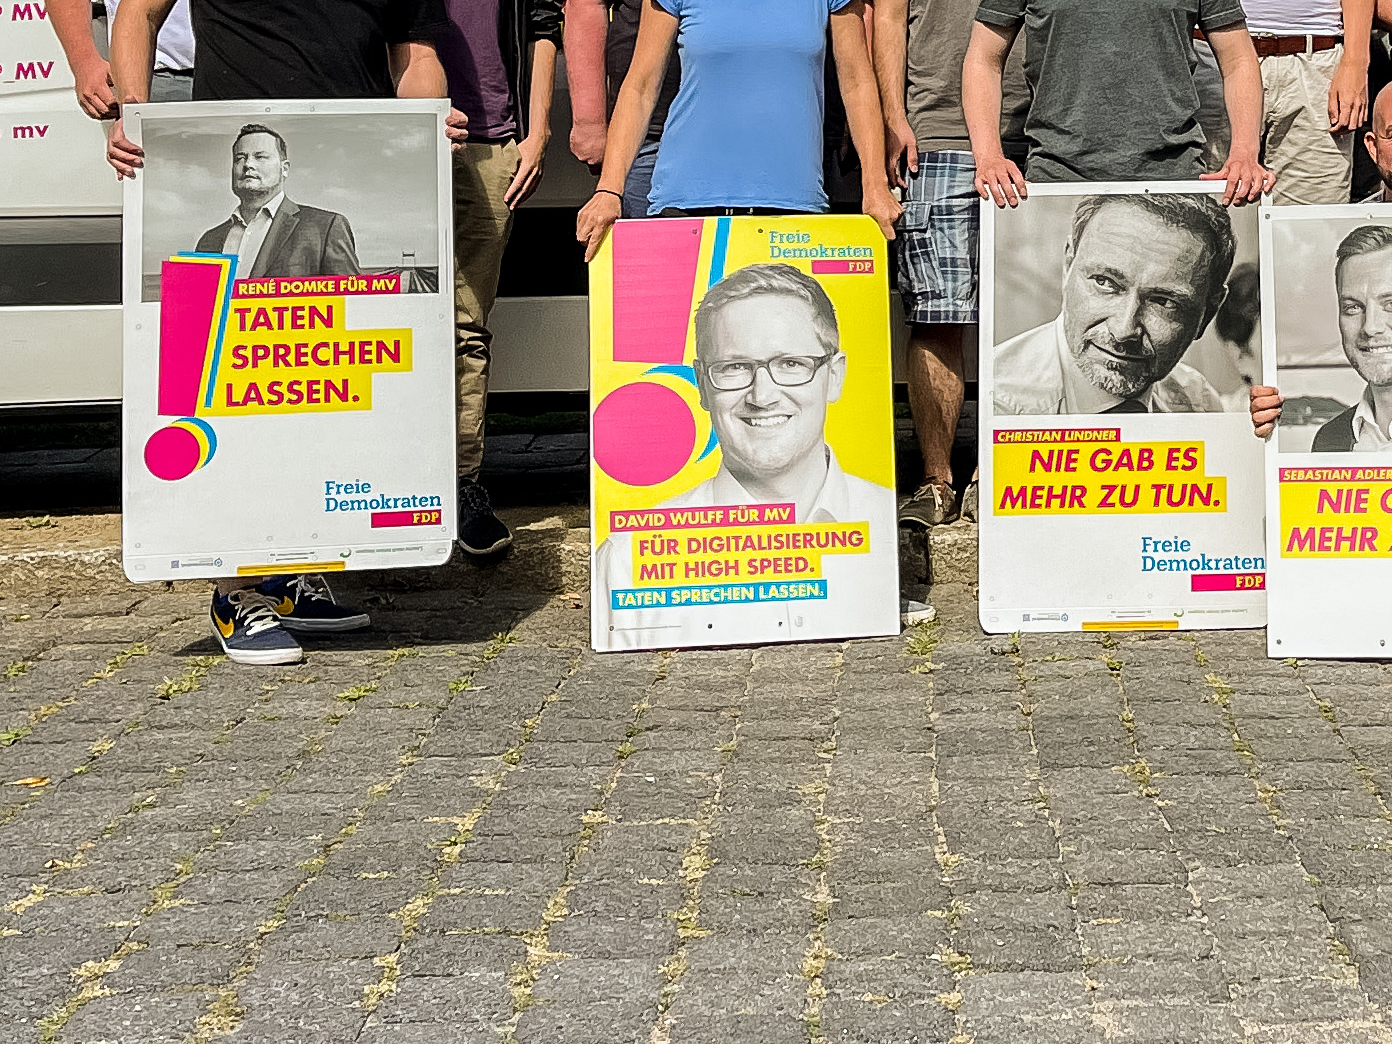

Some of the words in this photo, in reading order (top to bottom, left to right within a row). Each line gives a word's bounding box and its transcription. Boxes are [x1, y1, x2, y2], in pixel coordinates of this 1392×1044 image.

[11, 3, 48, 21] MV
[12, 125, 49, 138] mv
[769, 230, 810, 244] Freie
[769, 244, 874, 258] Demokraten
[848, 260, 872, 272] FDP
[238, 278, 276, 295] RENÉ
[280, 279, 335, 294] DOMKE
[340, 276, 368, 292] FÜR
[371, 278, 397, 291] MV
[234, 305, 333, 331] TATEN
[231, 339, 400, 370] SPRECHEN
[226, 378, 360, 407] LASSEN.
[997, 431, 1061, 442] CHRISTIAN
[1064, 430, 1117, 441] LINDNER
[1029, 448, 1080, 473] NIE
[1089, 447, 1154, 472] GAB
[1165, 447, 1198, 472] ES
[1283, 469, 1352, 481] SEBASTIAN
[325, 478, 371, 496] Freie
[999, 485, 1087, 509] MEHR
[1097, 484, 1140, 508] ZU
[1150, 483, 1221, 507] TUN.
[324, 493, 442, 512] Demokraten
[1317, 488, 1370, 514] NIE
[412, 512, 440, 524] FDP
[614, 513, 665, 529] DAVID
[669, 510, 724, 526] WULFF
[729, 506, 760, 523] FÜR
[764, 507, 791, 521] MV
[639, 534, 680, 556] FÜR
[687, 530, 864, 553] DIGITALISIERUNG
[1141, 536, 1192, 553] Freie
[1286, 526, 1378, 552] MEHR
[638, 562, 677, 581] MIT
[684, 559, 740, 579] HIGH
[747, 556, 815, 576] SPEED.
[1141, 553, 1266, 572] Demokraten
[1235, 575, 1264, 588] FDP
[616, 590, 666, 607] TATEN
[671, 587, 754, 604] SPRECHEN
[759, 583, 824, 600] LASSEN.
